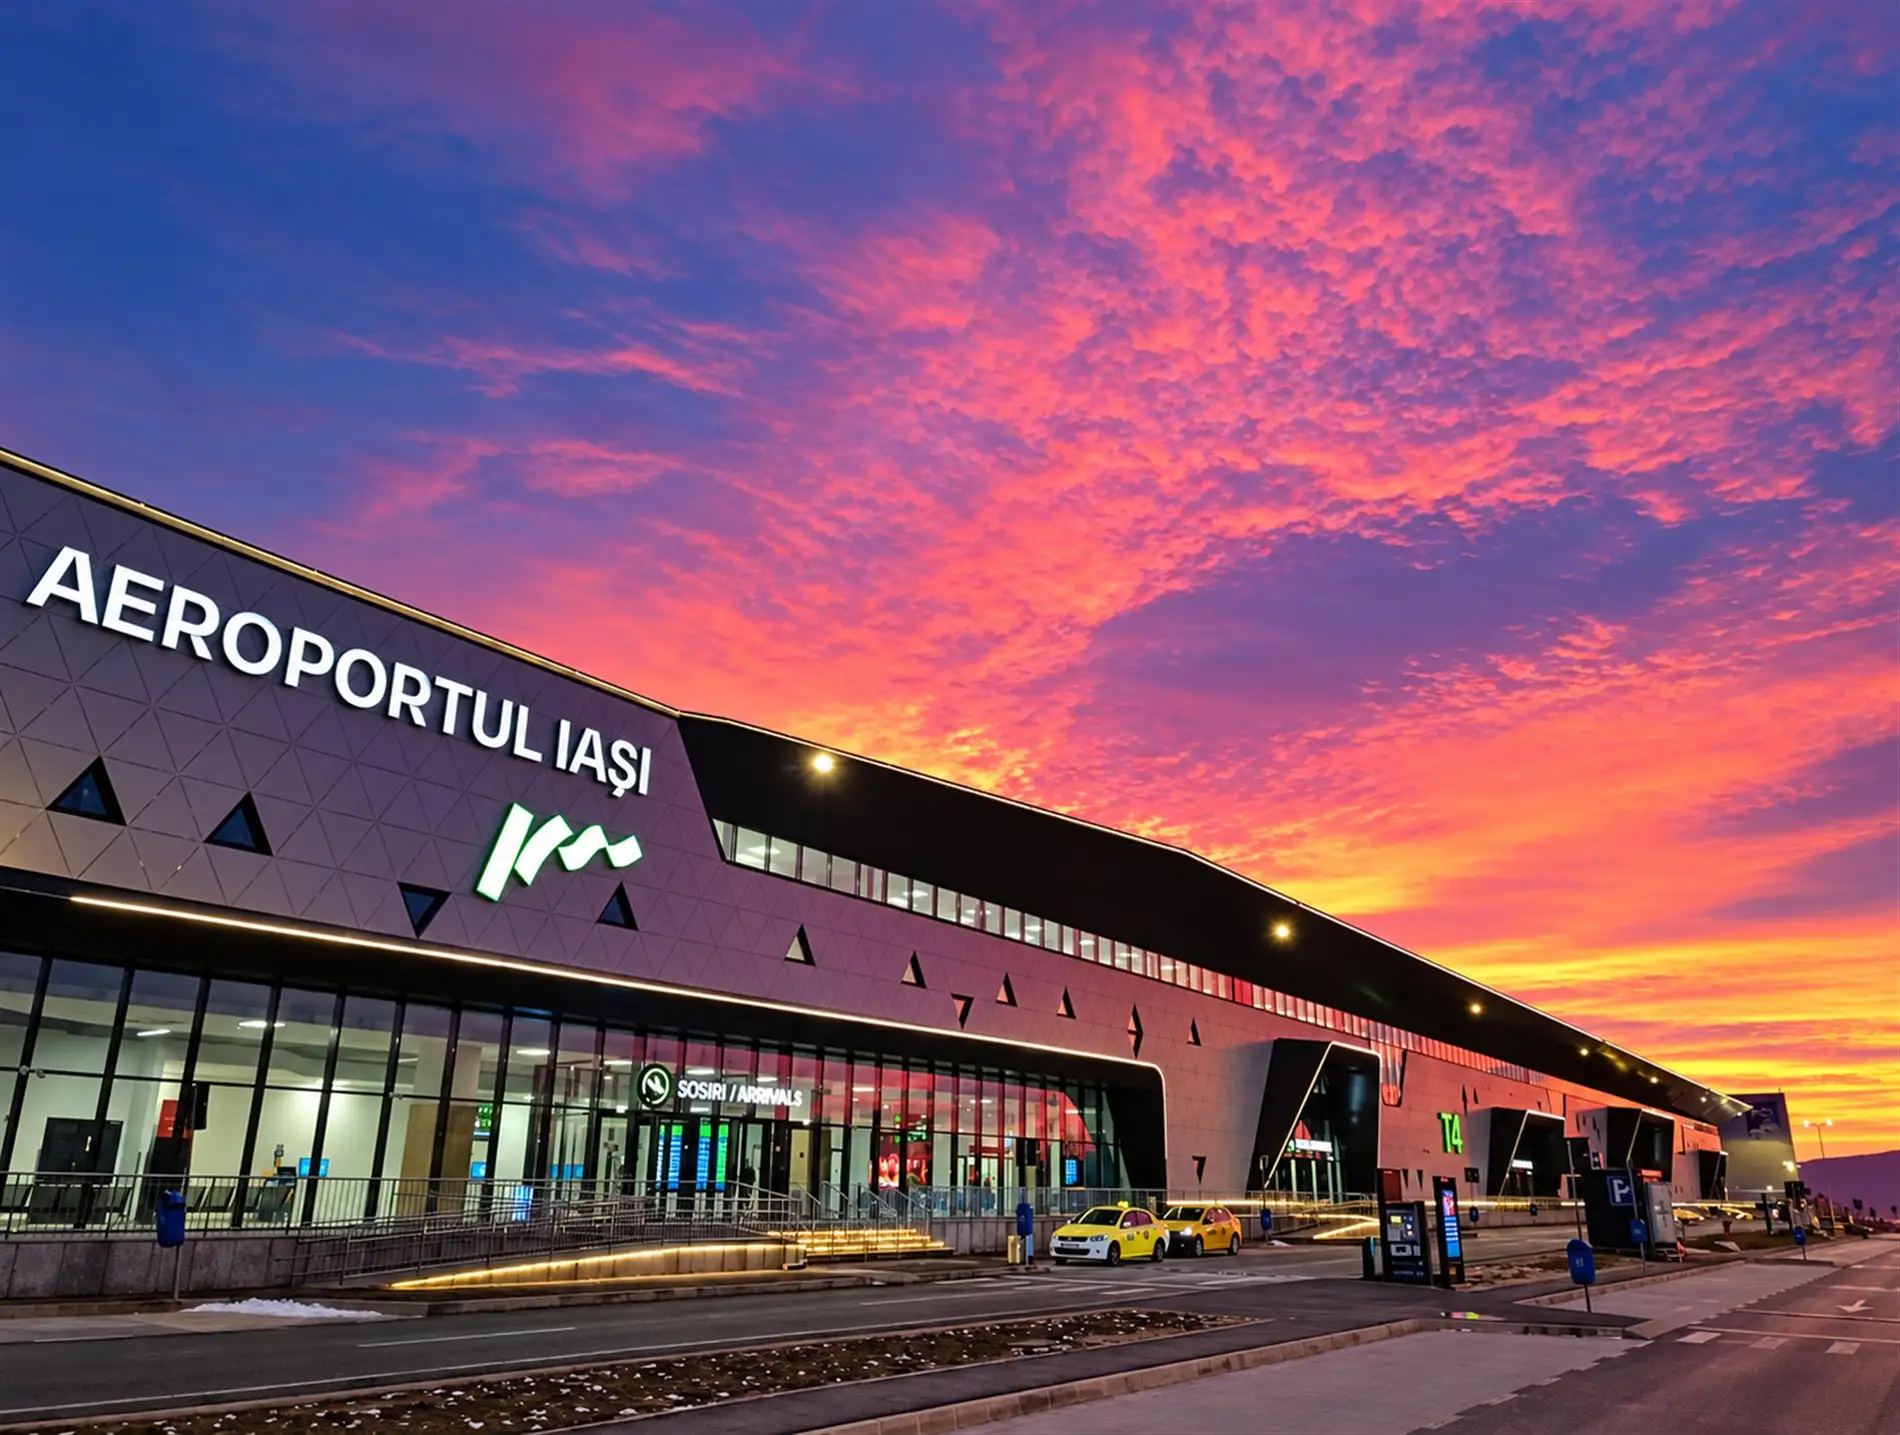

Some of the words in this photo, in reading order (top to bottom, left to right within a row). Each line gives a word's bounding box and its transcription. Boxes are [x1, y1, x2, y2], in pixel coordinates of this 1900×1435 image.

[26, 546, 542, 762] AEROPORTUL
[677, 1079, 727, 1101] SOSIRI
[737, 1085, 803, 1107] ARRIVALS
[1438, 1112, 1463, 1155] T4
